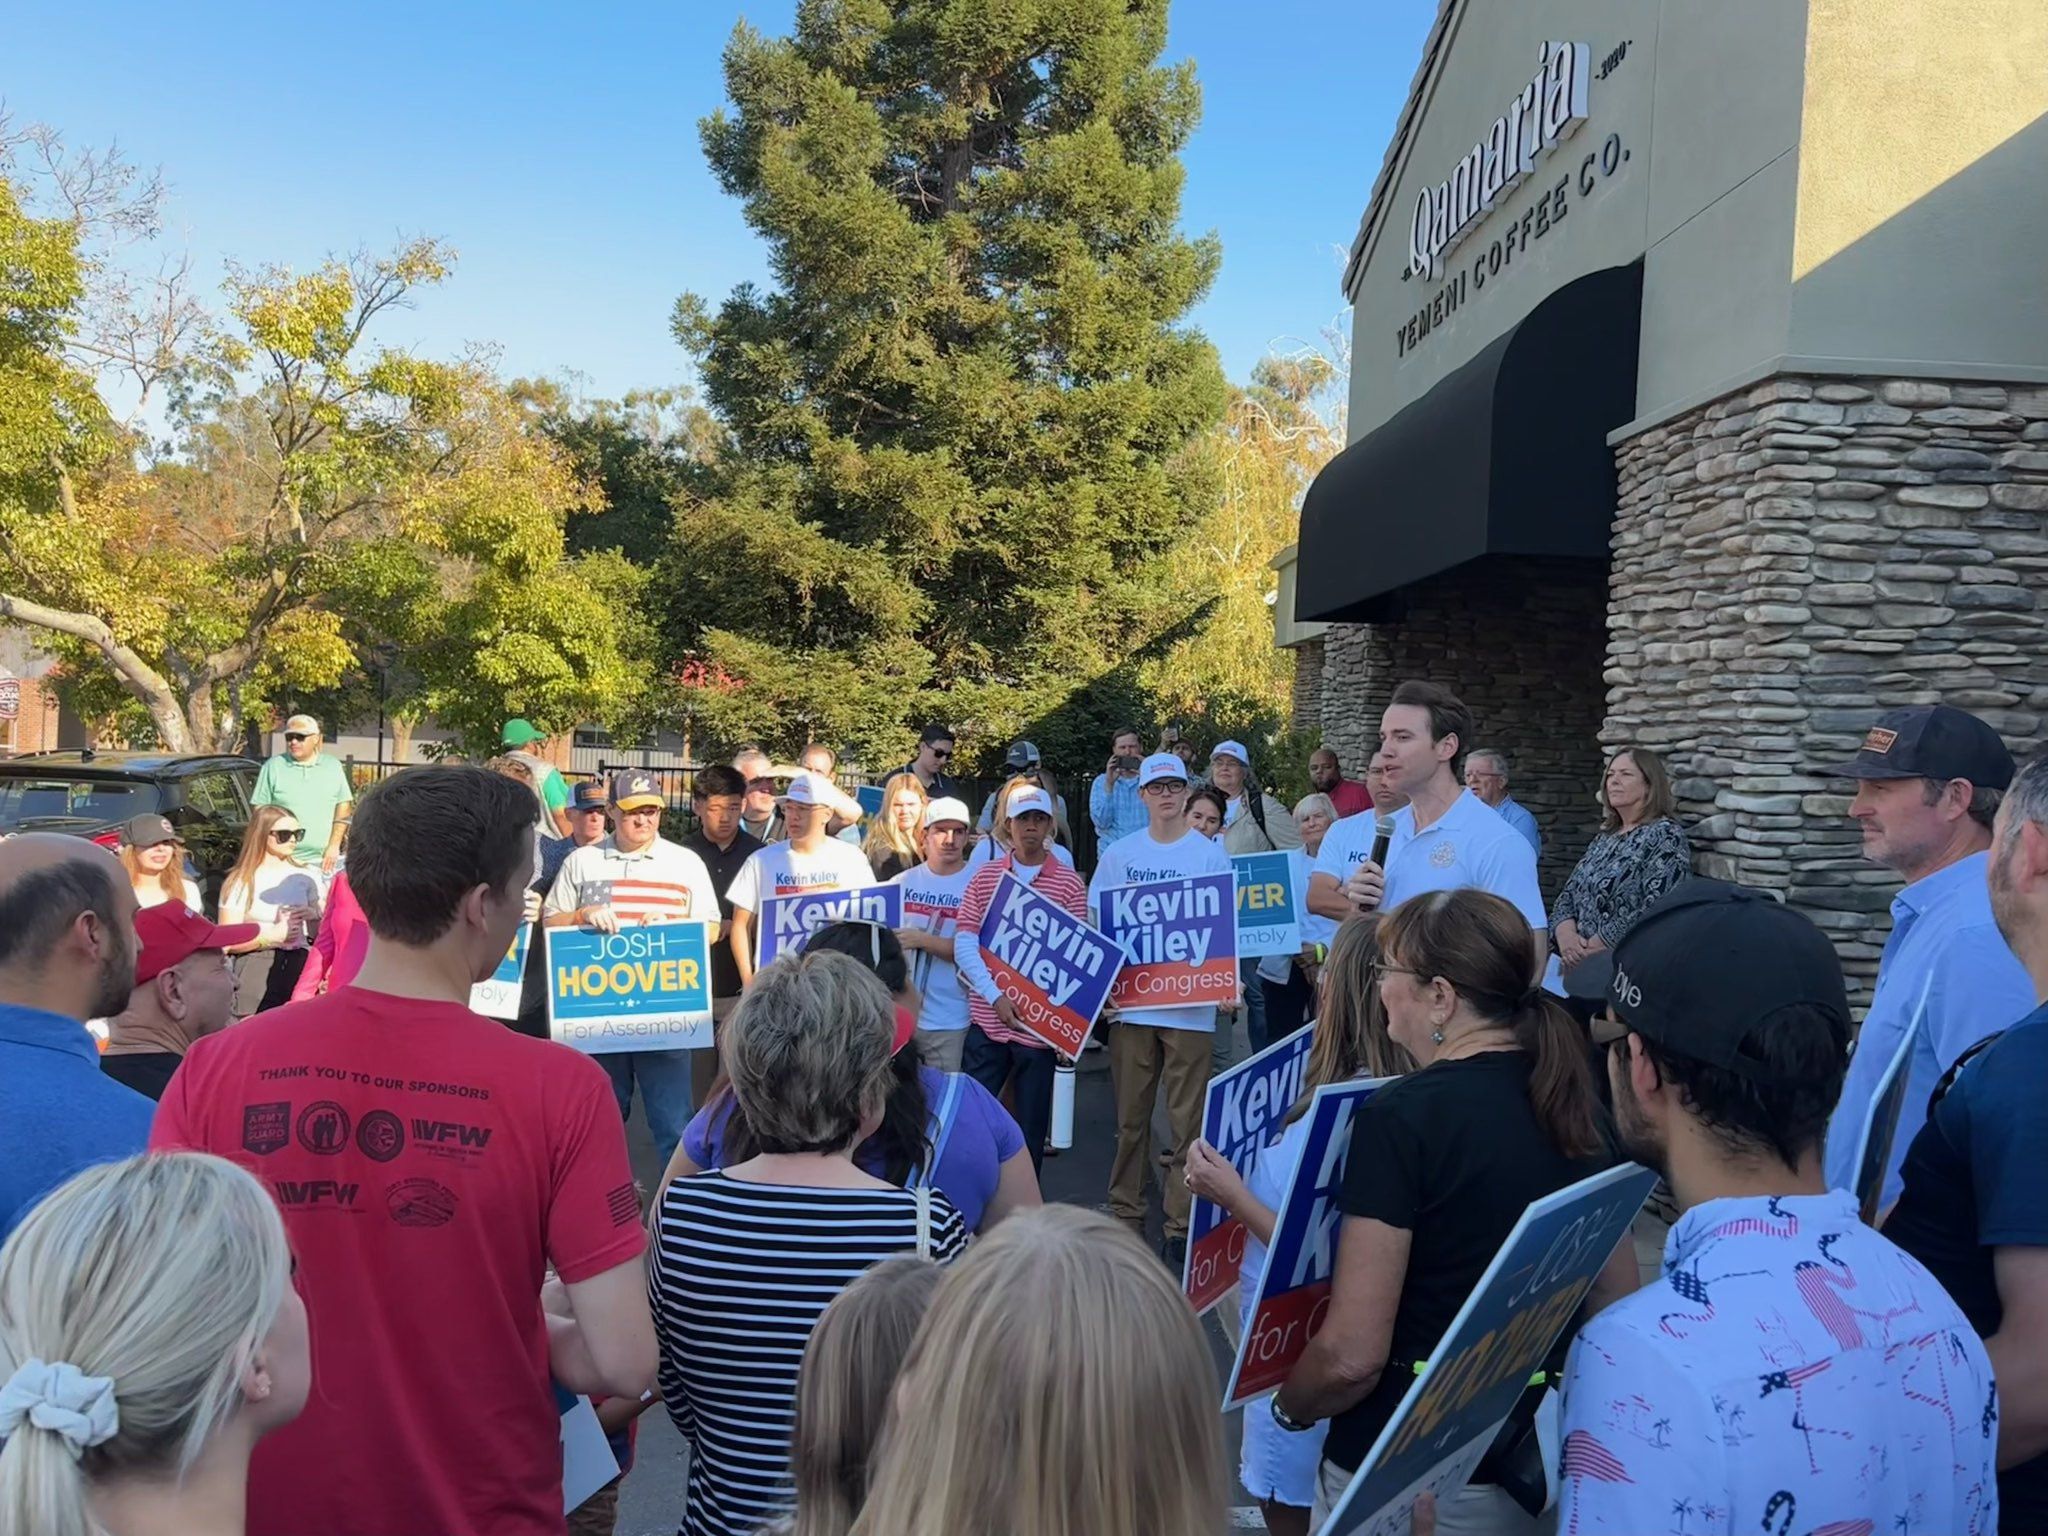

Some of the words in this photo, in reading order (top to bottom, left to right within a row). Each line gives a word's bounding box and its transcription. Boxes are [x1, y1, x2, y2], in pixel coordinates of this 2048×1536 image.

[1409, 40, 1584, 281] Qamaria
[1396, 270, 1467, 357] YEMENI
[1473, 173, 1569, 289] COFFEE
[1578, 132, 1631, 197] CO.
[775, 872, 808, 885] Kevin
[811, 871, 838, 884] Kiley
[1126, 866, 1157, 882] Kevin
[774, 889, 888, 935] Kevin
[904, 888, 936, 905] Kevin
[937, 892, 963, 907] Kile
[1112, 880, 1221, 928] Kevin
[590, 932, 667, 961] JOSH
[1001, 883, 1105, 977] Kevin
[1115, 923, 1213, 968] Kiley
[558, 958, 701, 998] HOOVER
[988, 919, 1083, 1007] Kiley
[1109, 980, 1129, 996] or
[1134, 970, 1235, 997] Congress
[994, 971, 1083, 1044] Congress
[563, 1022, 595, 1040] For
[601, 1015, 700, 1037] Assembly
[259, 1065, 309, 1081] THANK
[315, 1066, 347, 1081] YOU
[351, 1072, 371, 1085] TO
[375, 1077, 404, 1090] OUR
[408, 1081, 490, 1100] SPONSORS
[248, 1112, 285, 1124] ARMY
[248, 1128, 286, 1140] GUARD
[412, 1119, 492, 1148] VFW
[276, 1180, 360, 1205] VFW
[1190, 1247, 1222, 1295] for
[1247, 1311, 1298, 1367] for
